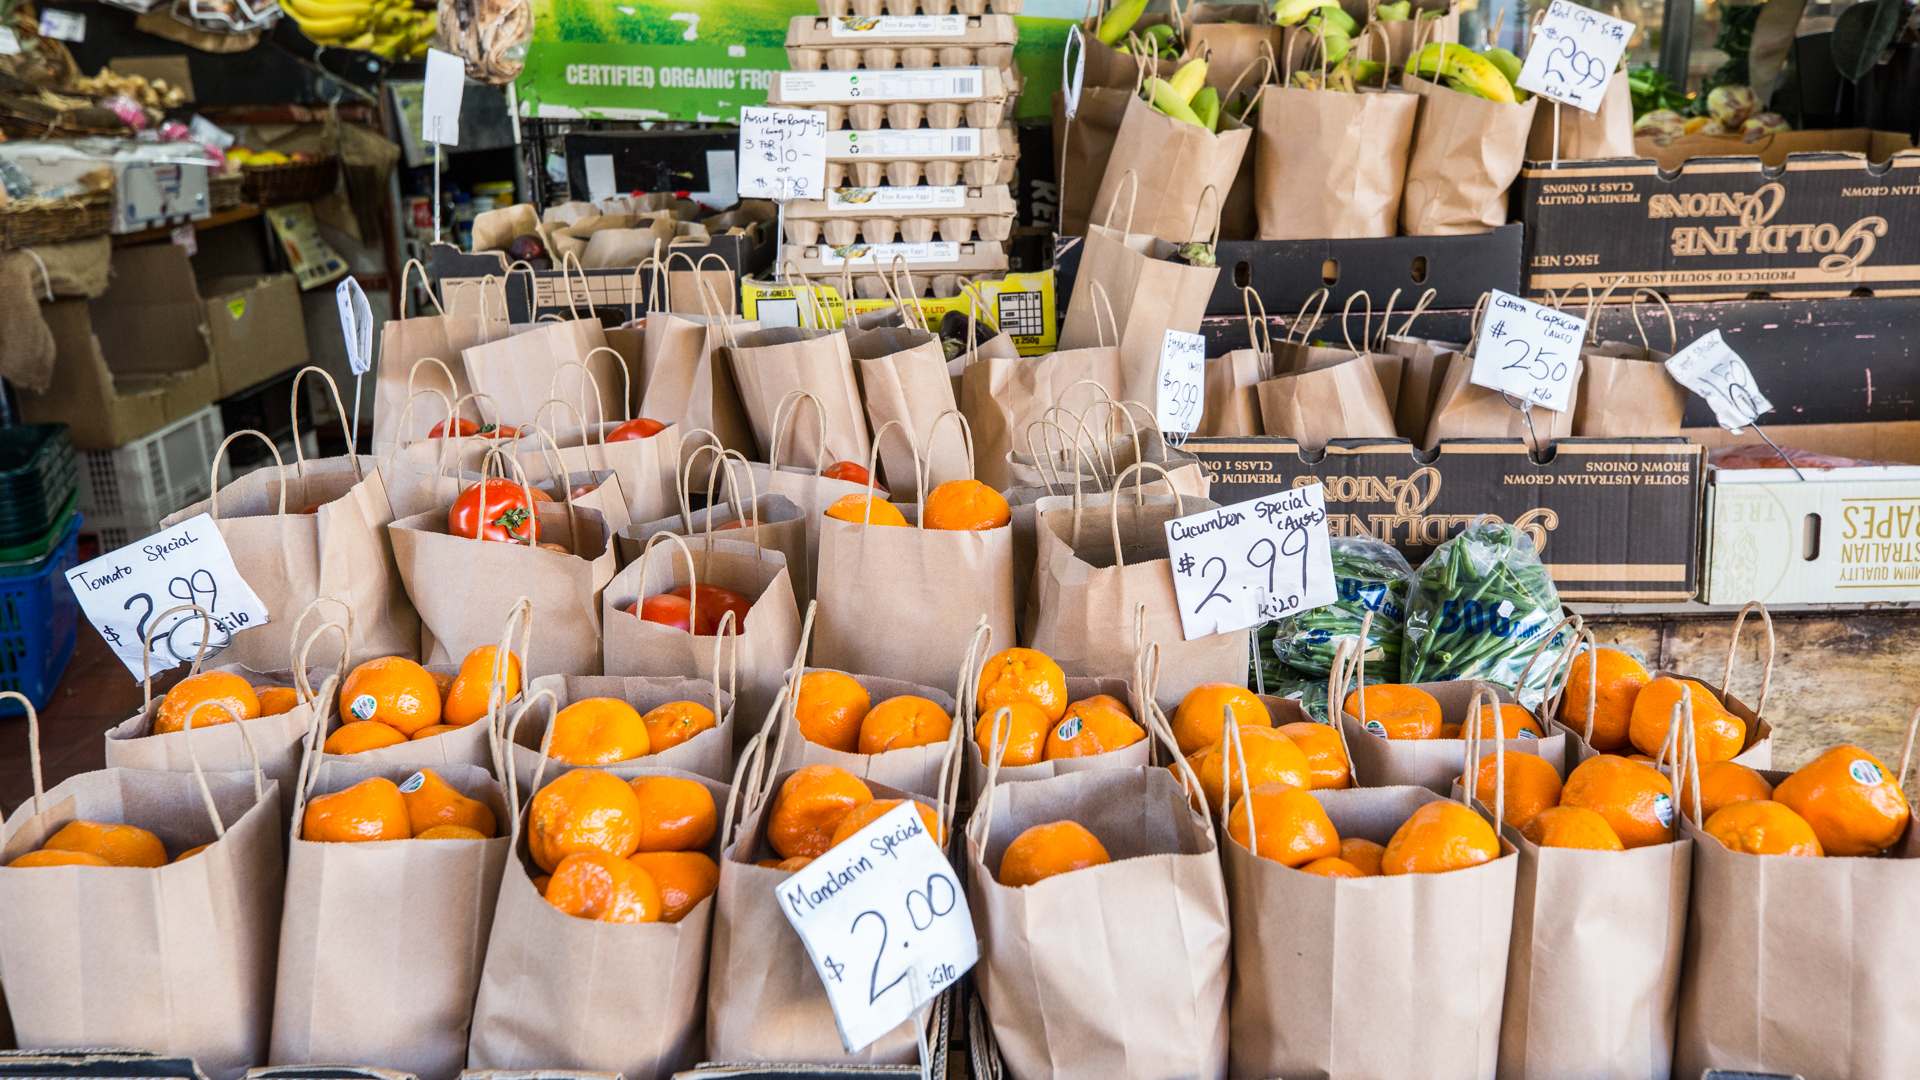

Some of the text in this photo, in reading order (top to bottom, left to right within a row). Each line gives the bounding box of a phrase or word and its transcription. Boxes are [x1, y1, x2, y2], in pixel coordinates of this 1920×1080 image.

[566, 64, 654, 88] CERTIFIED
[659, 66, 735, 88] ORGANIC
[745, 139, 754, 150] 3
[1543, 184, 1588, 194] ONIONS
[1599, 182, 1634, 192] CLASS
[1841, 187, 1888, 197] GROWN
[1536, 193, 1641, 206] PREMIUM QUALITY
[1649, 183, 1785, 228] ONIONS
[1671, 215, 1889, 278] GOLDLINE
[1531, 253, 1600, 267] 15KG NET
[1670, 273, 1715, 283] SOUTH
[1719, 272, 1733, 282] OF
[1736, 269, 1796, 281] PRODUCE
[1495, 294, 1580, 331] Green Capsicum
[1502, 339, 1568, 382] 250
[1225, 460, 1233, 470] 1
[1235, 460, 1273, 471] CLASS
[1586, 461, 1690, 473] BROWN ONIONS
[1223, 473, 1282, 484] PREMIUM
[1504, 474, 1690, 485] SOUTH AUSTRALIAN GROWN
[1254, 489, 1312, 524] Special
[1178, 527, 1309, 615] $ 2.99
[1840, 566, 1888, 581] QUALITY
[71, 566, 132, 591] Tomato
[103, 569, 217, 653] $ 2.99
[214, 610, 249, 633] Kilo
[788, 817, 923, 917] Mandarin Special
[824, 873, 956, 1006] $ 2.00
